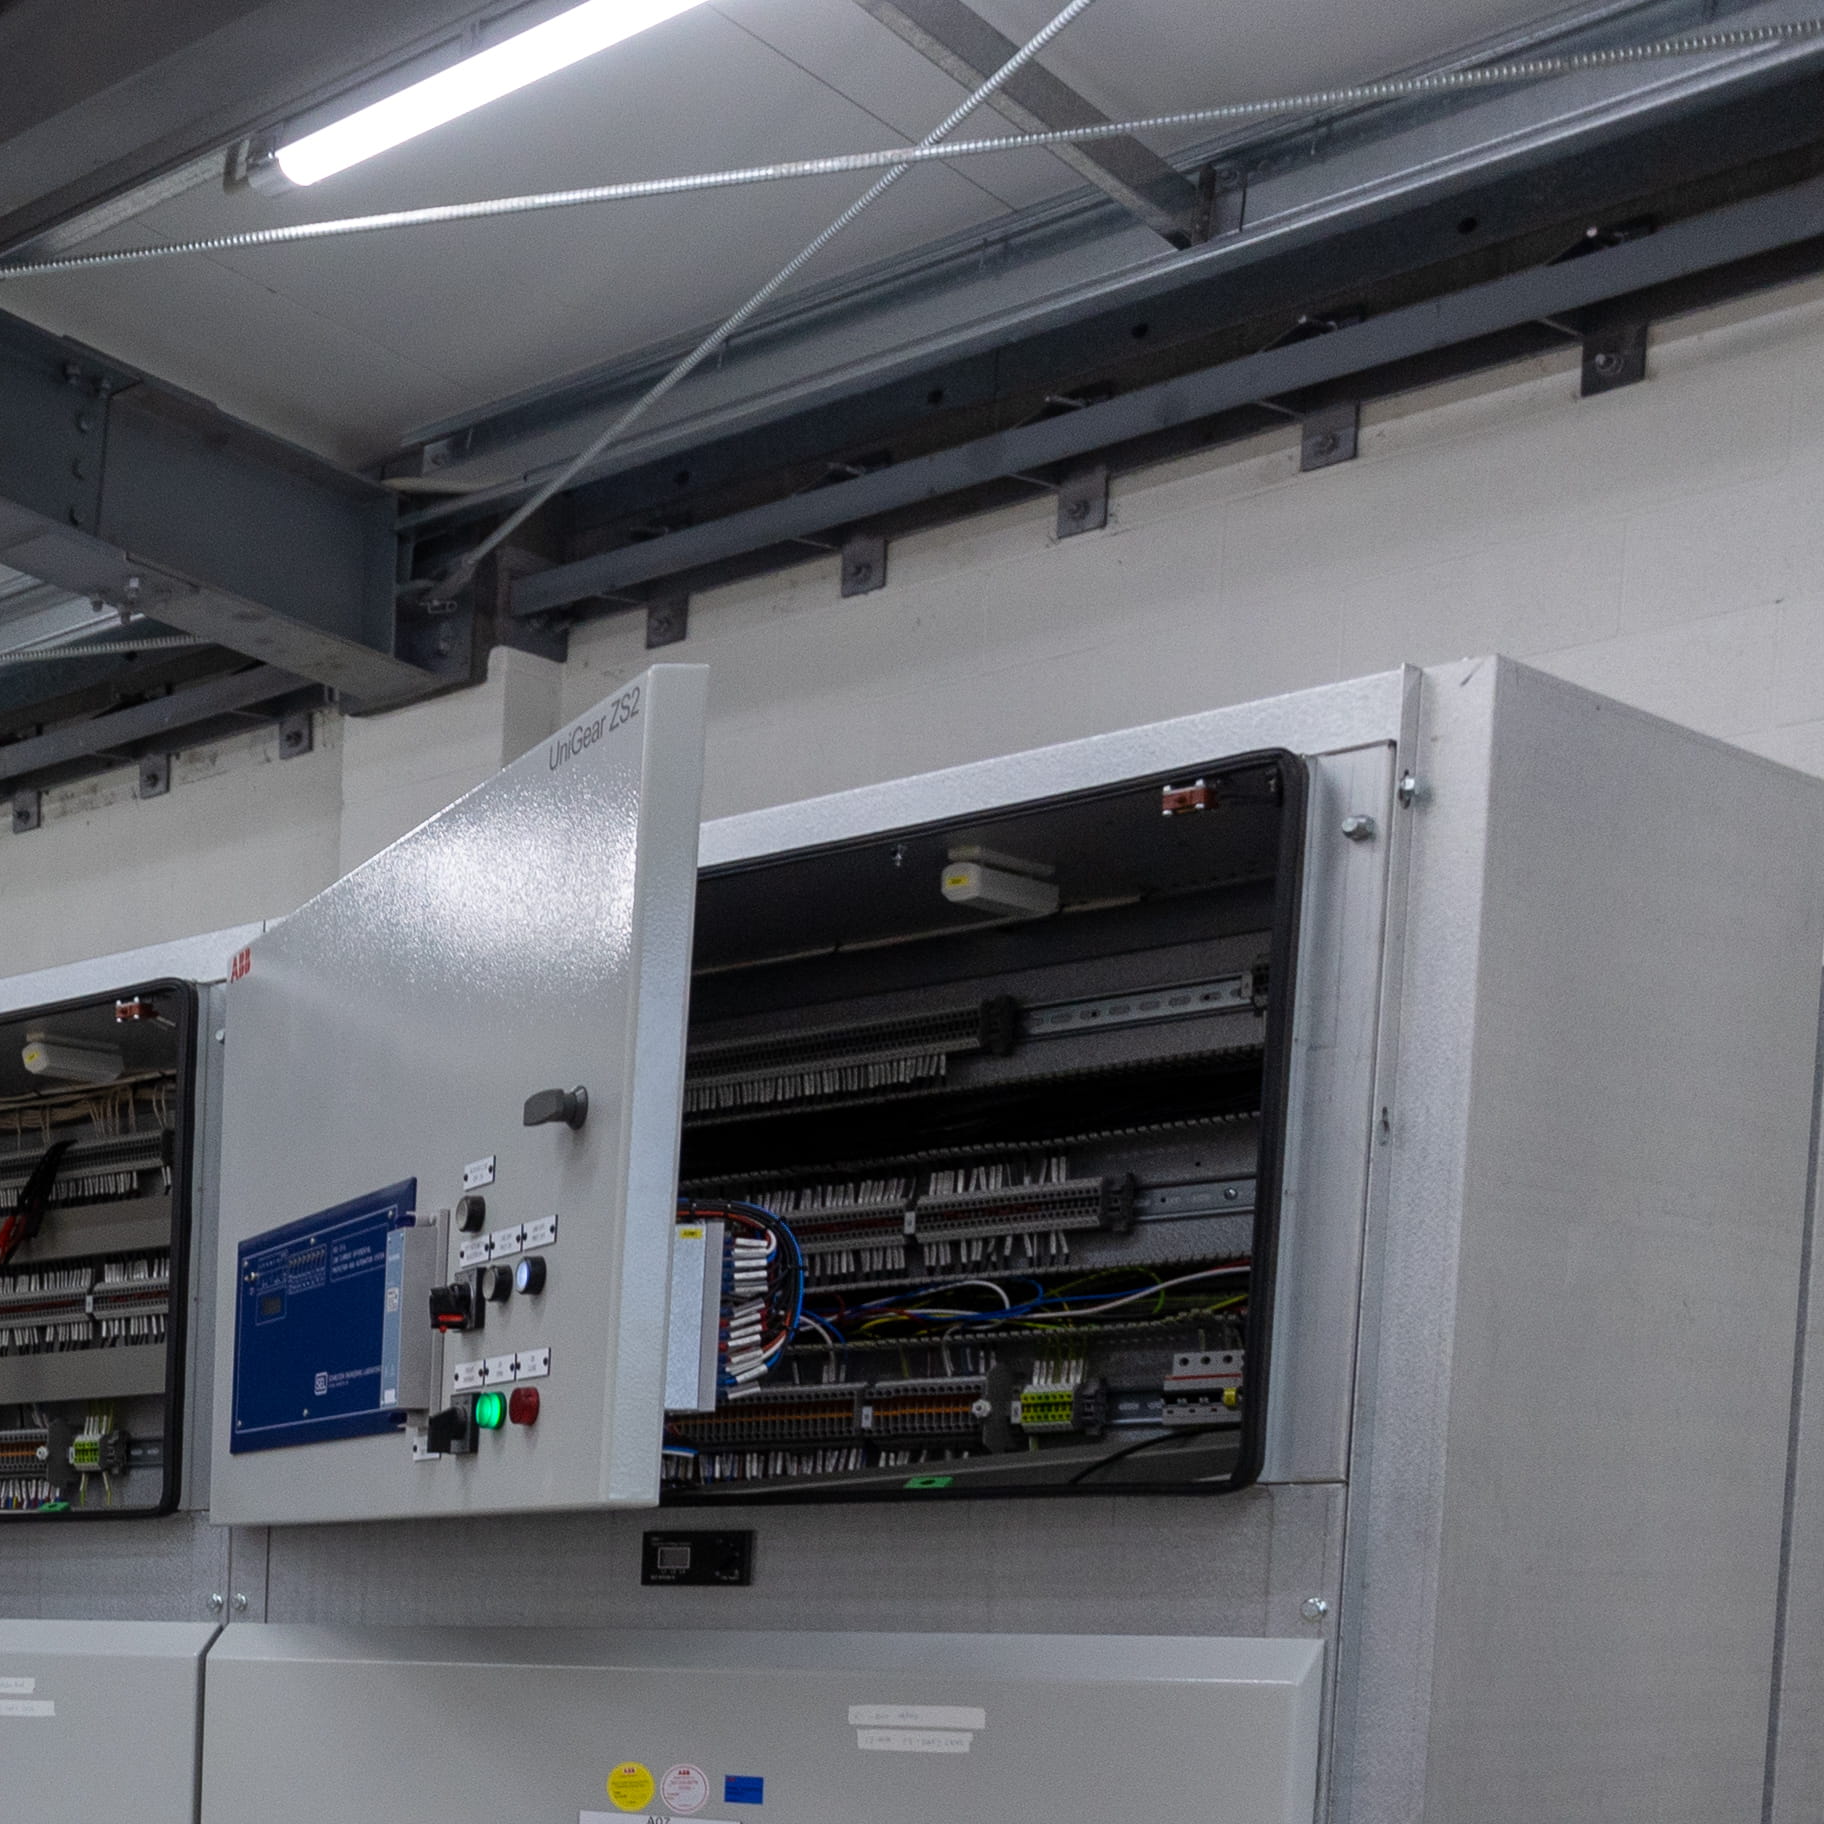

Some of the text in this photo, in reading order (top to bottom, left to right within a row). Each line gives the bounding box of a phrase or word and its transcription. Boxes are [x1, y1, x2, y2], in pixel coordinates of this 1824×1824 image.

[549, 686, 641, 771] UniGear ZS2
[231, 947, 251, 984] ABB
